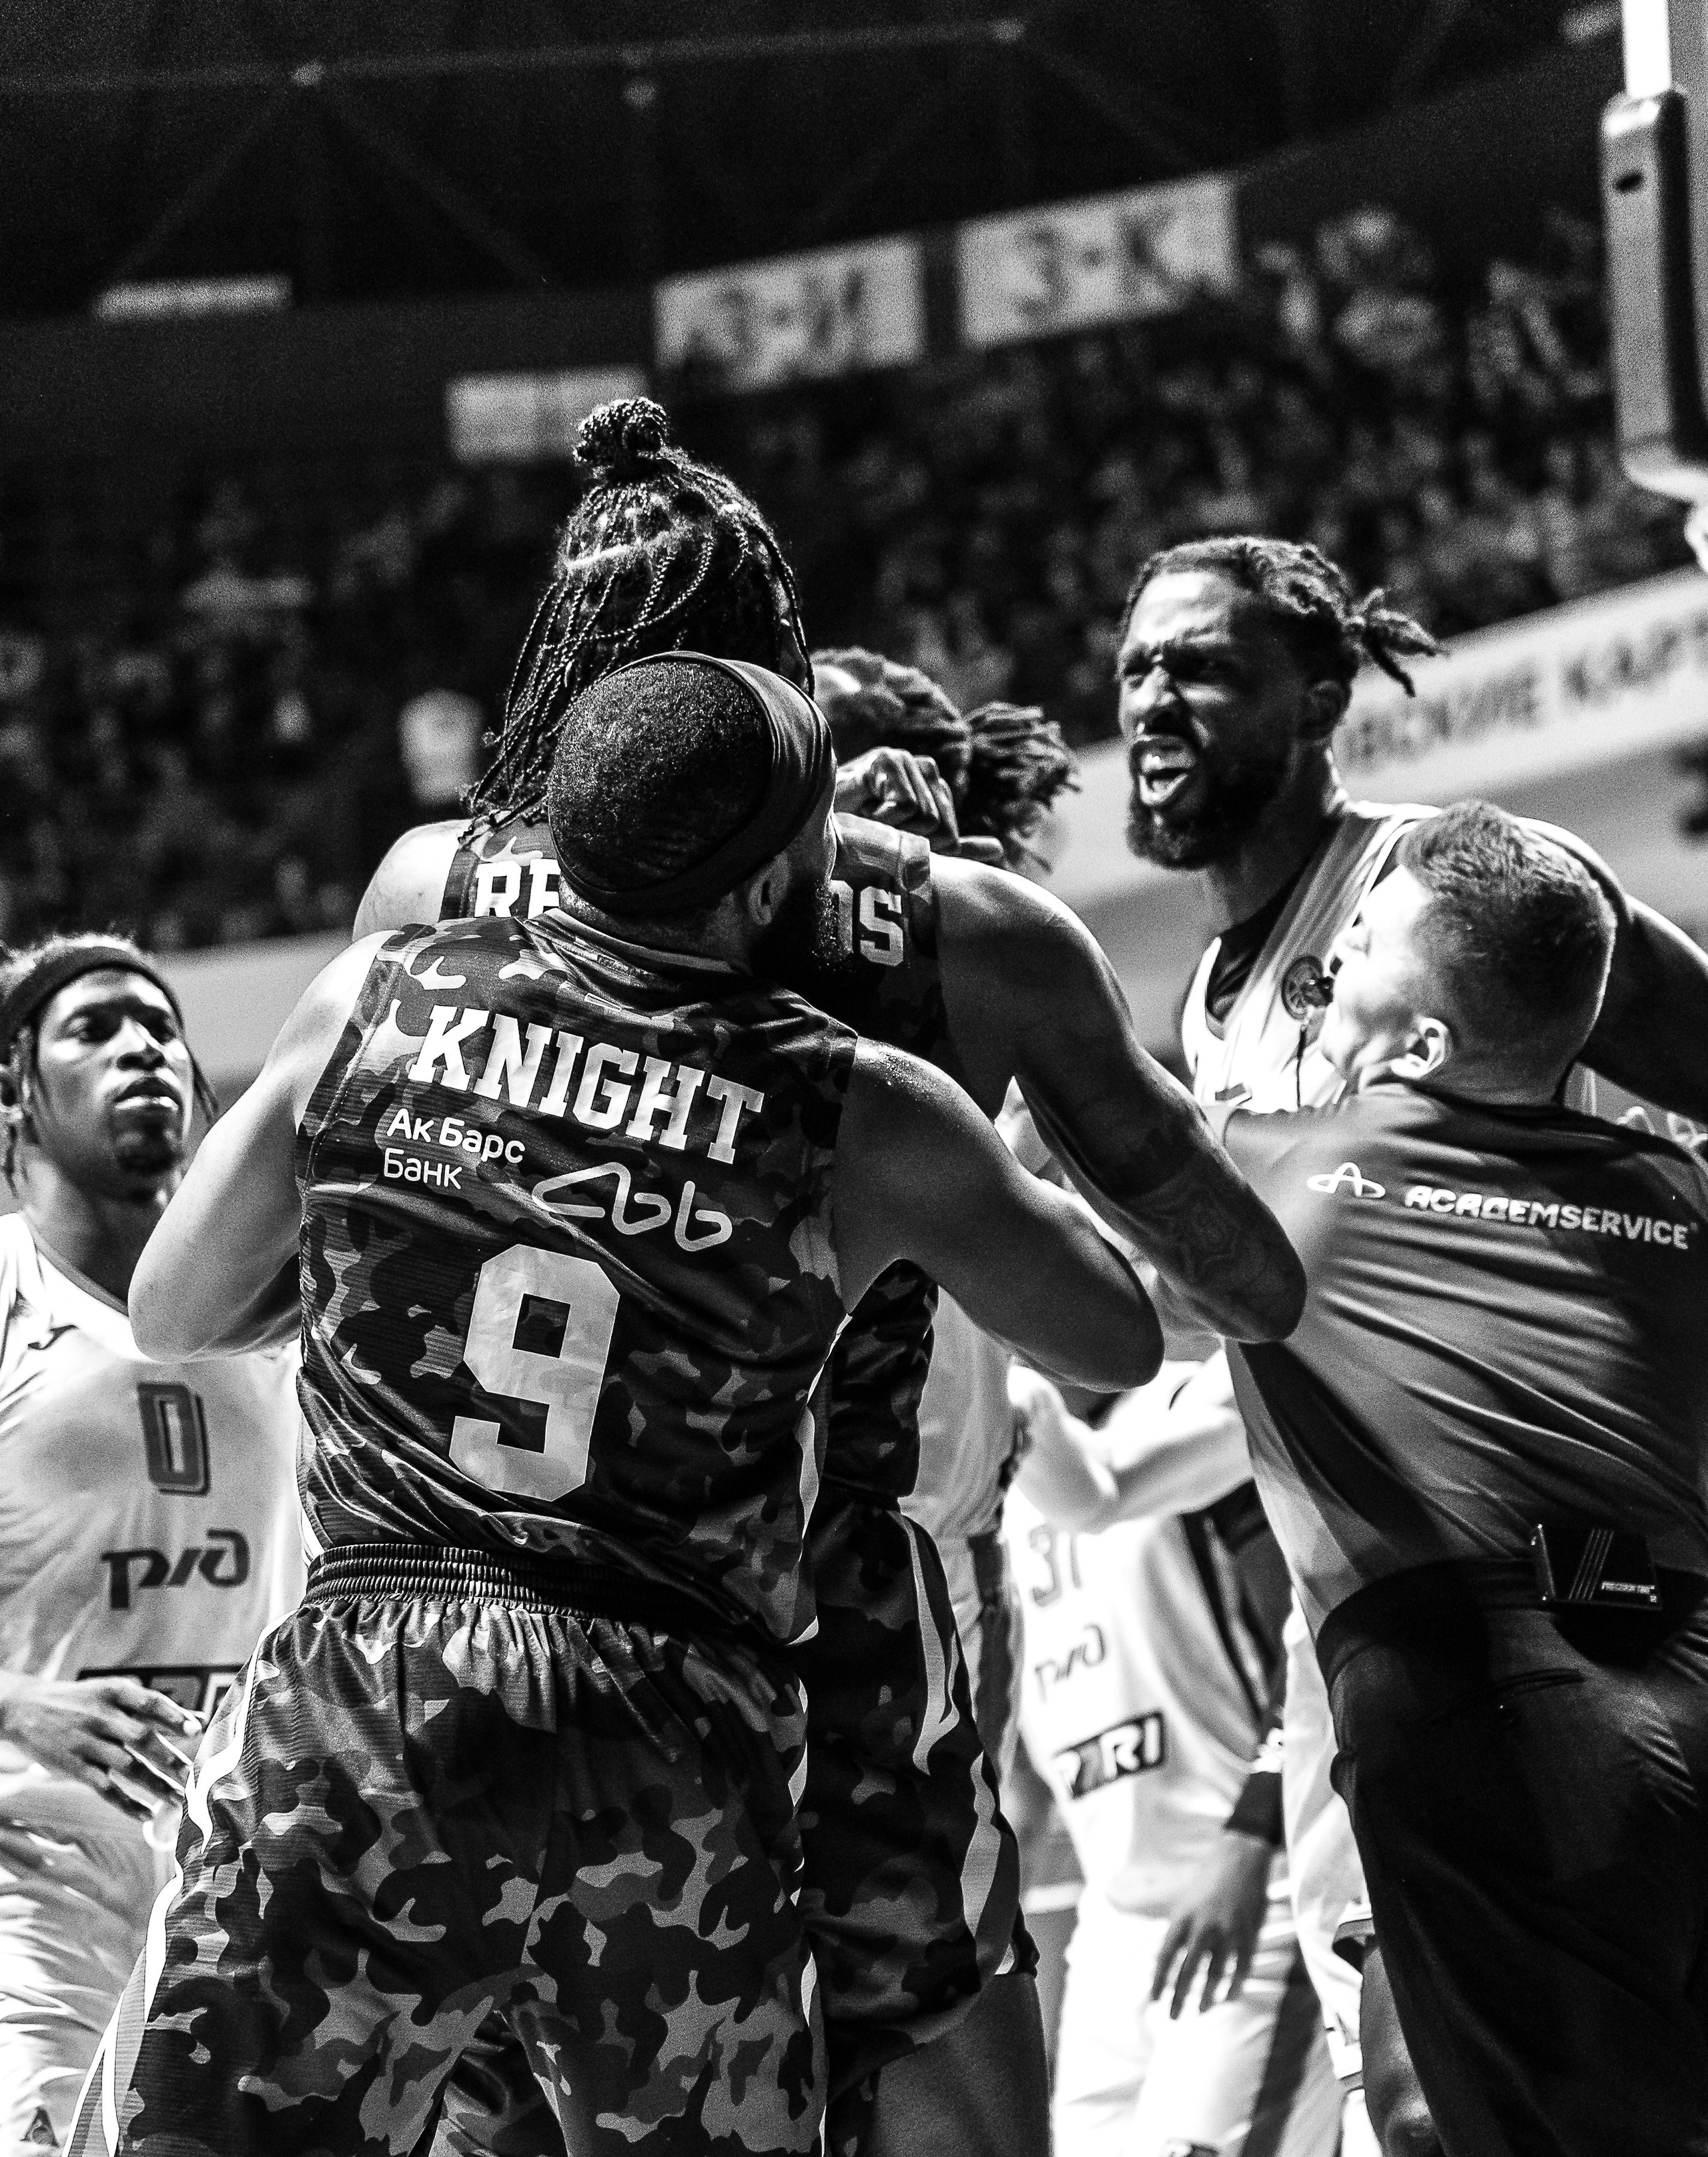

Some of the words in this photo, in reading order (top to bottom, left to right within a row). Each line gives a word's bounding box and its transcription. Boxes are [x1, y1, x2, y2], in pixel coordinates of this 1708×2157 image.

[386, 1108, 434, 1142] Ак
[438, 1117, 526, 1165] Барс
[407, 1004, 765, 1165] KNIGHT
[384, 1147, 462, 1190] Банк
[448, 1244, 620, 1502] 9
